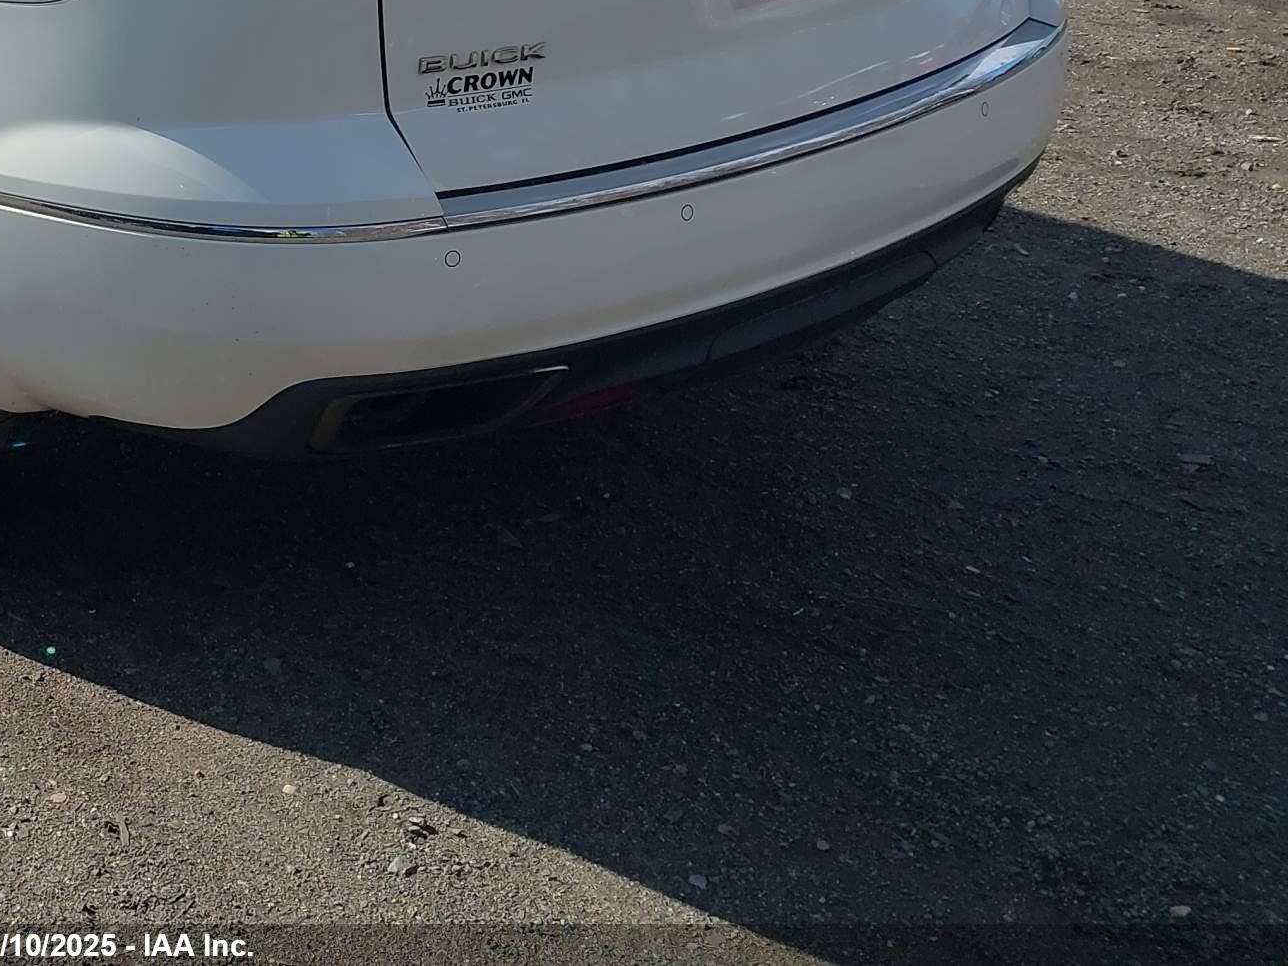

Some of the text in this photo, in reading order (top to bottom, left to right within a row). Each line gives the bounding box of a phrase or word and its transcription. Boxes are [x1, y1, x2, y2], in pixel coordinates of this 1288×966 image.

[418, 42, 546, 74] BUICK
[447, 66, 534, 94] CROWN
[448, 88, 532, 107] BUICK GMC
